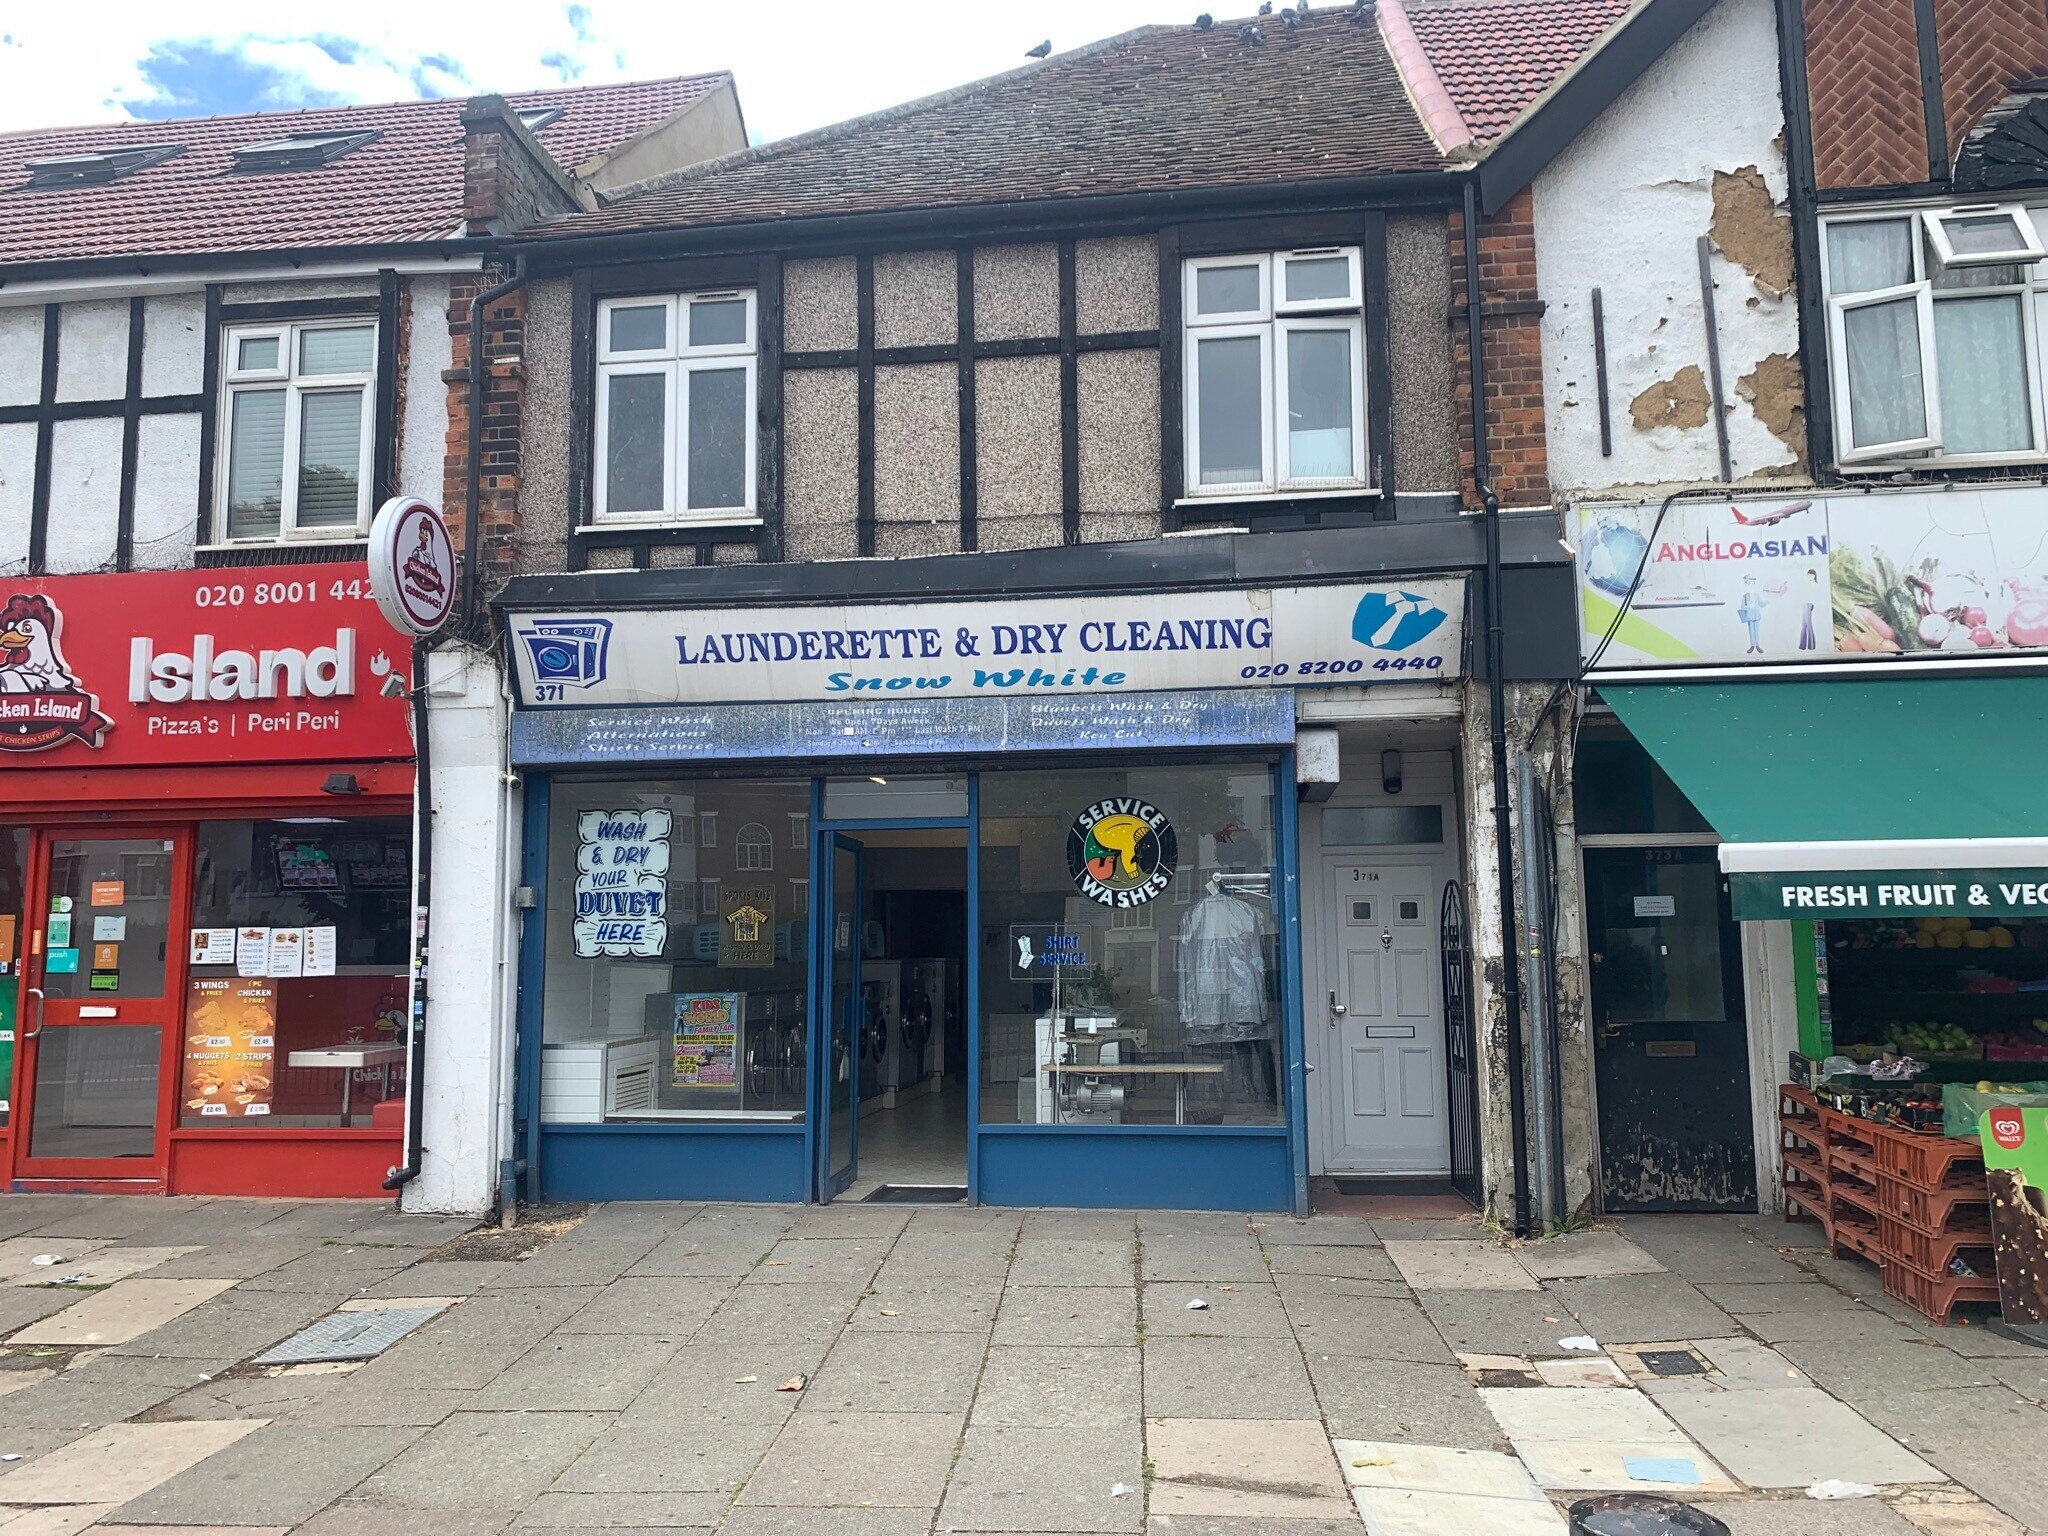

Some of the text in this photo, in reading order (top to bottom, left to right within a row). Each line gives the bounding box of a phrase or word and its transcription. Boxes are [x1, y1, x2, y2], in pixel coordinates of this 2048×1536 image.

[1656, 535, 1828, 563] ANGLOASIAN
[195, 584, 245, 607] 020
[254, 581, 316, 605] 8001
[675, 618, 1272, 664] LAUNDERETTE & DRY CLEANING
[129, 628, 356, 703] Island
[1241, 656, 1443, 678] 020 8200 4440
[825, 667, 1126, 691] Snow White
[535, 685, 564, 701] 371
[33, 698, 83, 720] Island
[888, 707, 930, 715] HOURS
[1110, 701, 1154, 712] Wash
[1162, 701, 1172, 710] &
[1180, 700, 1208, 712] Dry
[148, 709, 339, 735] Pizza's Peri Peri
[587, 717, 653, 727] Service
[845, 718, 868, 727] Open
[1093, 714, 1136, 725] Wash
[1163, 713, 1190, 726] Dry
[1079, 798, 1165, 830] SERVICE
[597, 820, 648, 841] WASH
[592, 846, 651, 866] & DRY
[592, 869, 627, 887] YOUR
[1353, 869, 1380, 881] 371A
[1080, 873, 1169, 908] WASHES
[1782, 885, 1868, 907] FRESH
[1878, 884, 1956, 906] FRUIT
[1968, 884, 1991, 906] &
[578, 890, 663, 917] DUVET
[596, 923, 646, 942] HERE
[1045, 935, 1081, 949] SHIRT
[48, 951, 67, 959] push
[733, 951, 759, 960] HERE
[1039, 952, 1086, 966] SERVICE
[201, 981, 229, 989] WINGS
[237, 989, 272, 997] CHICKEN
[692, 999, 720, 1012] KIDS
[684, 1010, 728, 1025] WORLD
[193, 1052, 230, 1060] NUGGETS
[236, 1052, 272, 1060] 2 STRIPS
[353, 1067, 397, 1082] Chickn
